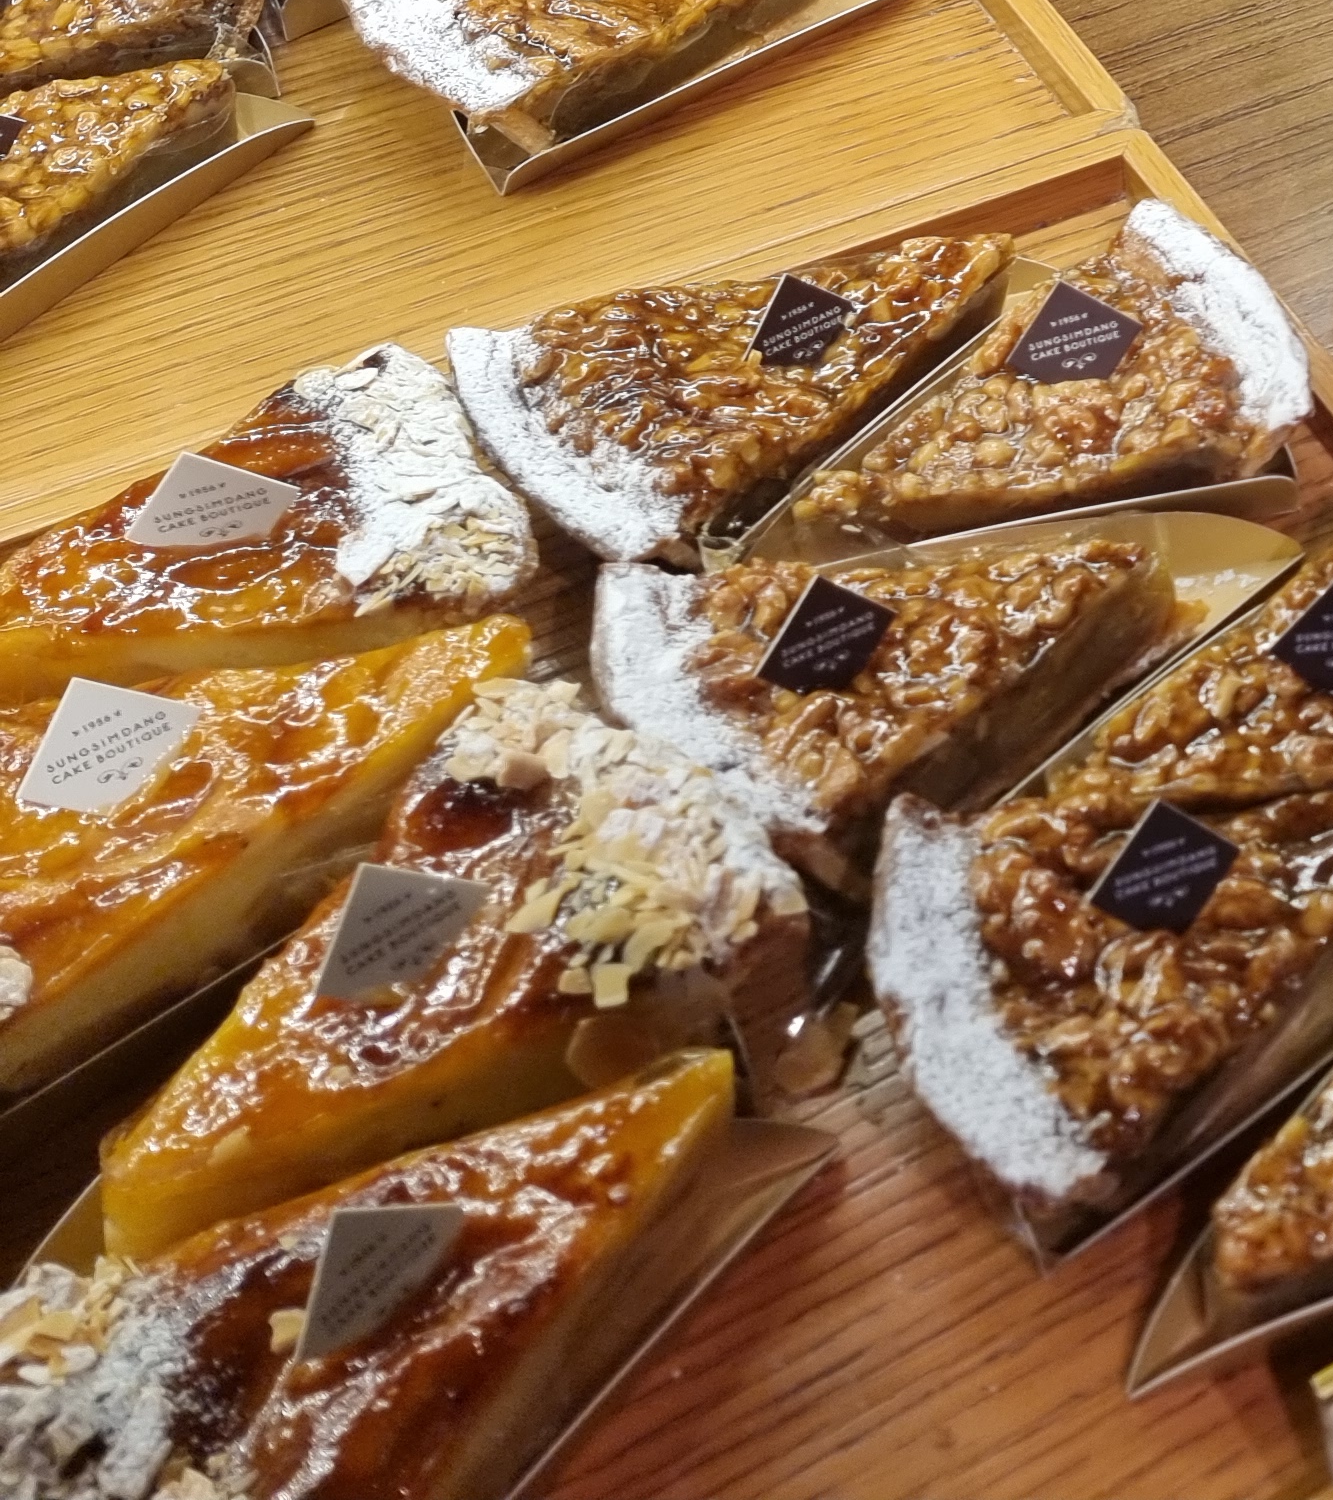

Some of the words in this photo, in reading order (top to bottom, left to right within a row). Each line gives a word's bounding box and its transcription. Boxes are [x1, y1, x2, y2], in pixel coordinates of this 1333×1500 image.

[765, 339, 792, 357] CAKE
[793, 315, 843, 344] BOUTIQUE
[1030, 346, 1062, 361] CAKE
[1063, 330, 1122, 353] BOUTIQUE
[157, 517, 196, 534] CAKE
[200, 497, 272, 522] BOUTIQUE
[82, 715, 112, 733] 1956
[51, 760, 93, 785] CAKE
[96, 721, 173, 764] BOUTIQUE
